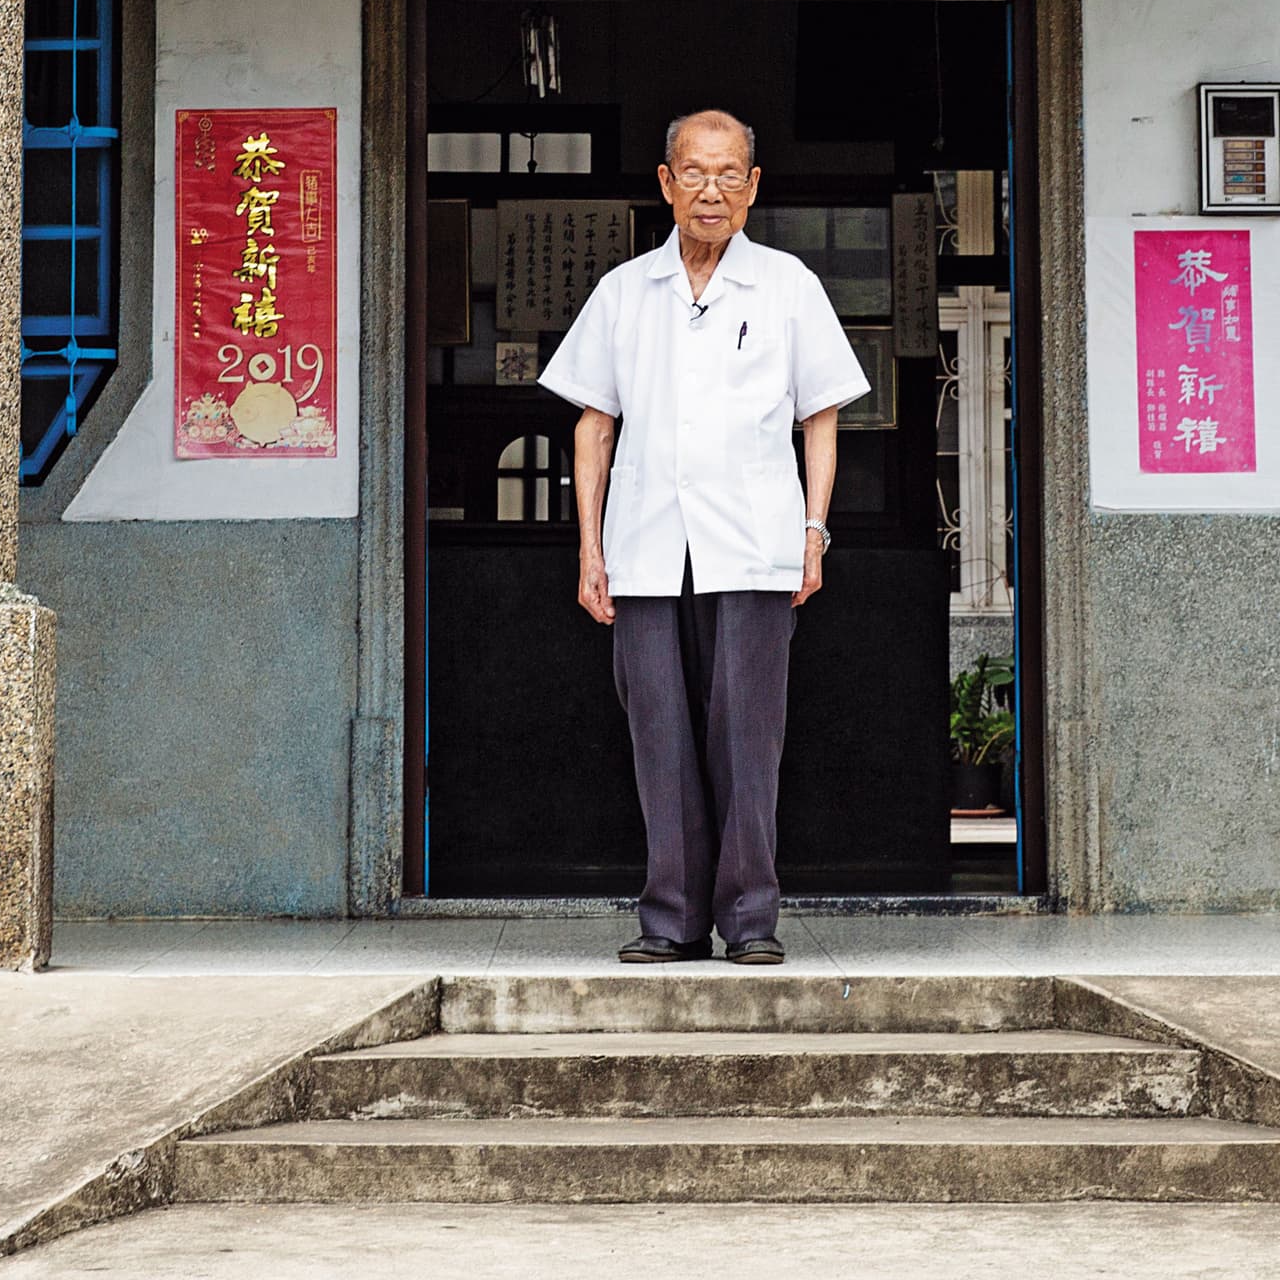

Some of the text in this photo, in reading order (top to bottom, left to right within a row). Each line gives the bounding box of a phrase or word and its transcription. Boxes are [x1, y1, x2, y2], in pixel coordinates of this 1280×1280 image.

[232, 132, 286, 339] 恭賀新禧
[217, 343, 324, 403] 2019
[1169, 249, 1228, 454] 恭賀新禧
